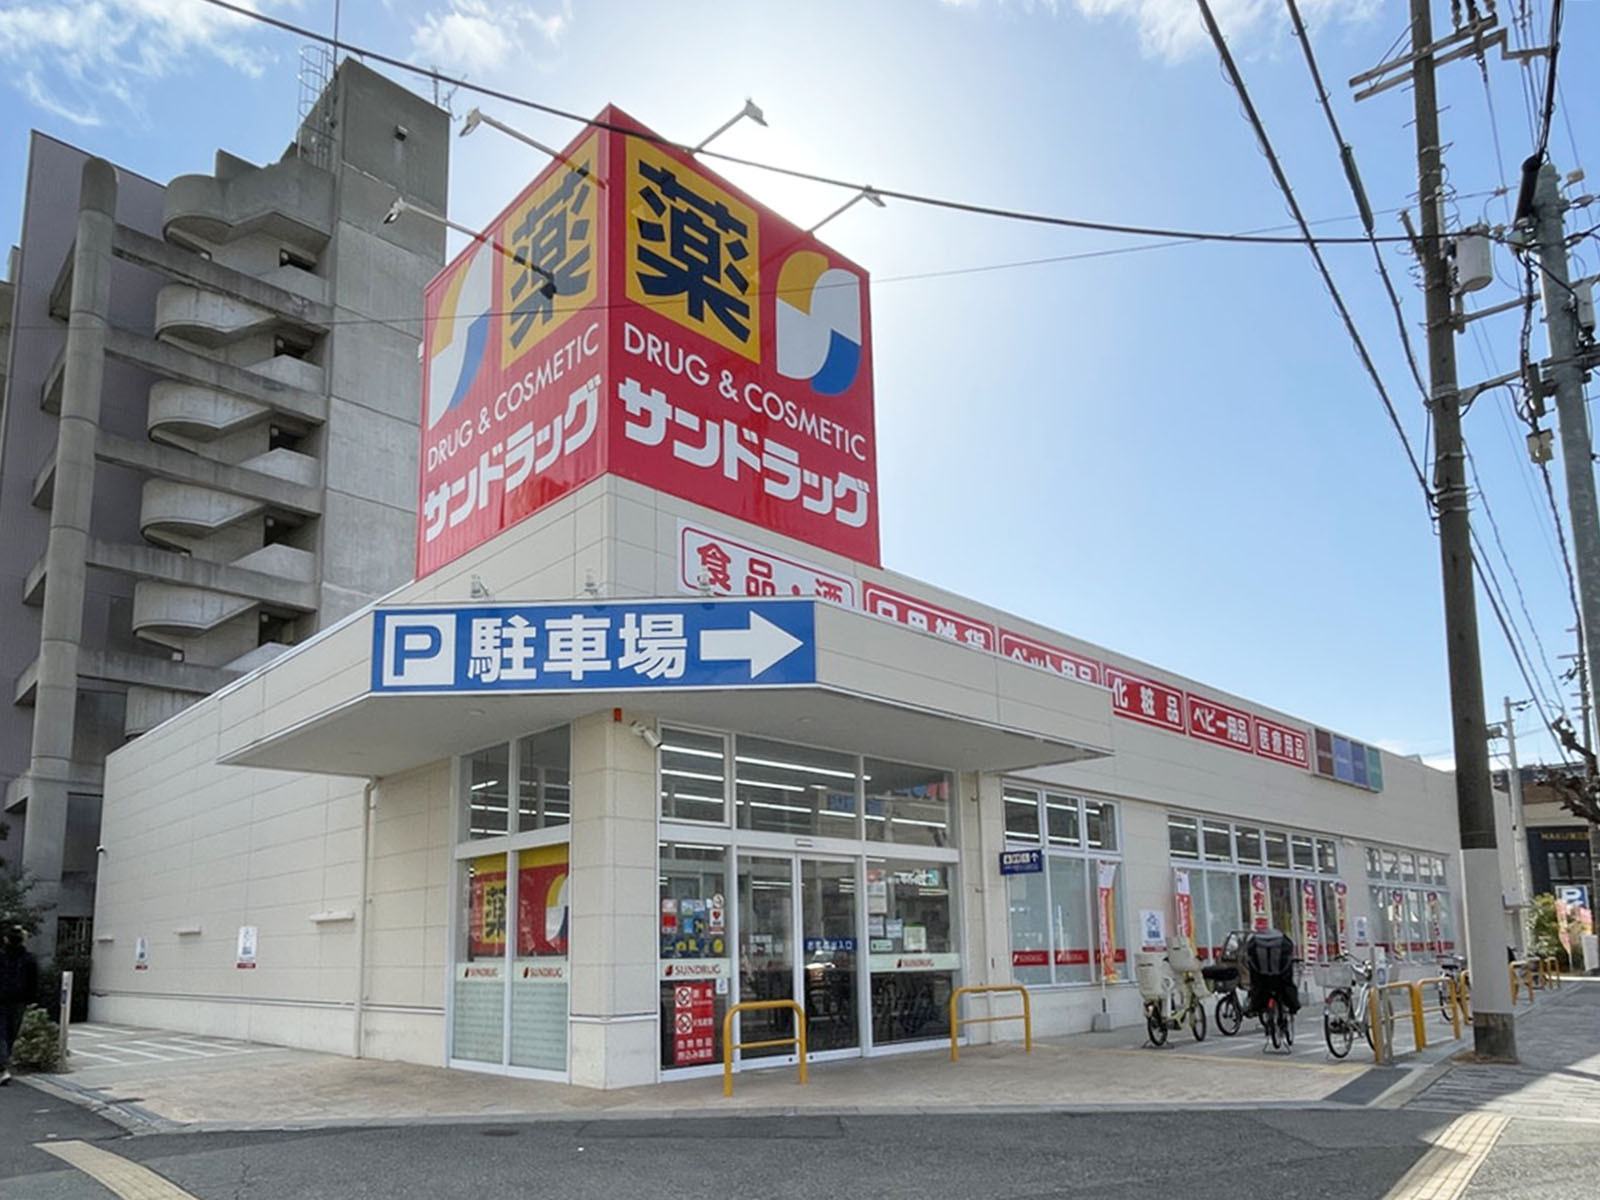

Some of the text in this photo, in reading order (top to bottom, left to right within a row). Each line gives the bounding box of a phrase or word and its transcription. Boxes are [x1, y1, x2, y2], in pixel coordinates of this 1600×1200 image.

[509, 158, 591, 350] 薬
[636, 159, 751, 344] 薬
[424, 374, 602, 543] サンドラッグ
[427, 322, 600, 472] DRUG & COSMETIC
[617, 376, 870, 528] サンドラッグ
[625, 322, 867, 461] DRUG & COSMETIC
[393, 613, 688, 684] P 駐車場
[1112, 677, 1180, 724] 化粧品
[1193, 706, 1249, 744] ベビー用品
[675, 964, 721, 976] SUNDRUG
